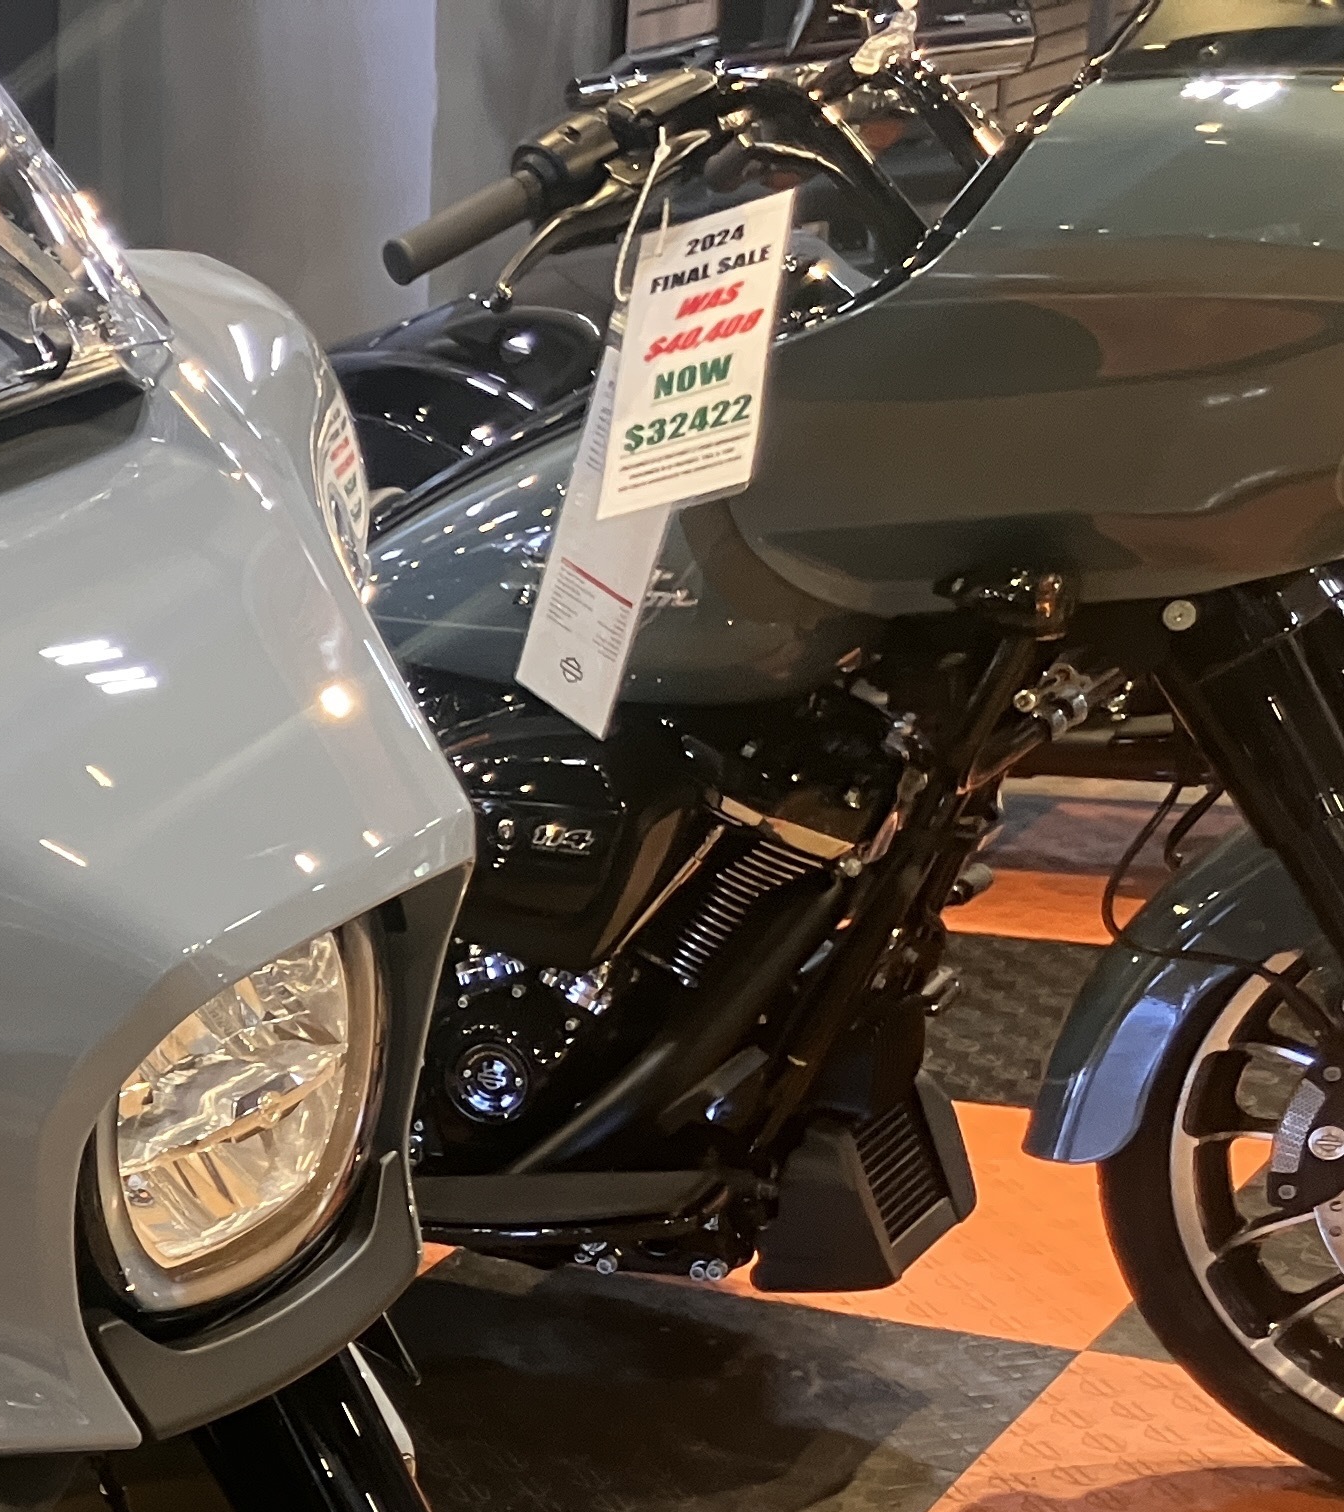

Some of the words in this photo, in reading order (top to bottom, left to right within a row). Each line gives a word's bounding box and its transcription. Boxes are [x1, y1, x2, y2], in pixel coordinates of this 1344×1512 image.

[684, 223, 745, 258] 2024
[649, 262, 711, 295] FINAL
[716, 244, 772, 275] SALE
[674, 280, 745, 321] WAS
[653, 353, 734, 400] NOW
[623, 393, 753, 454] $32422
